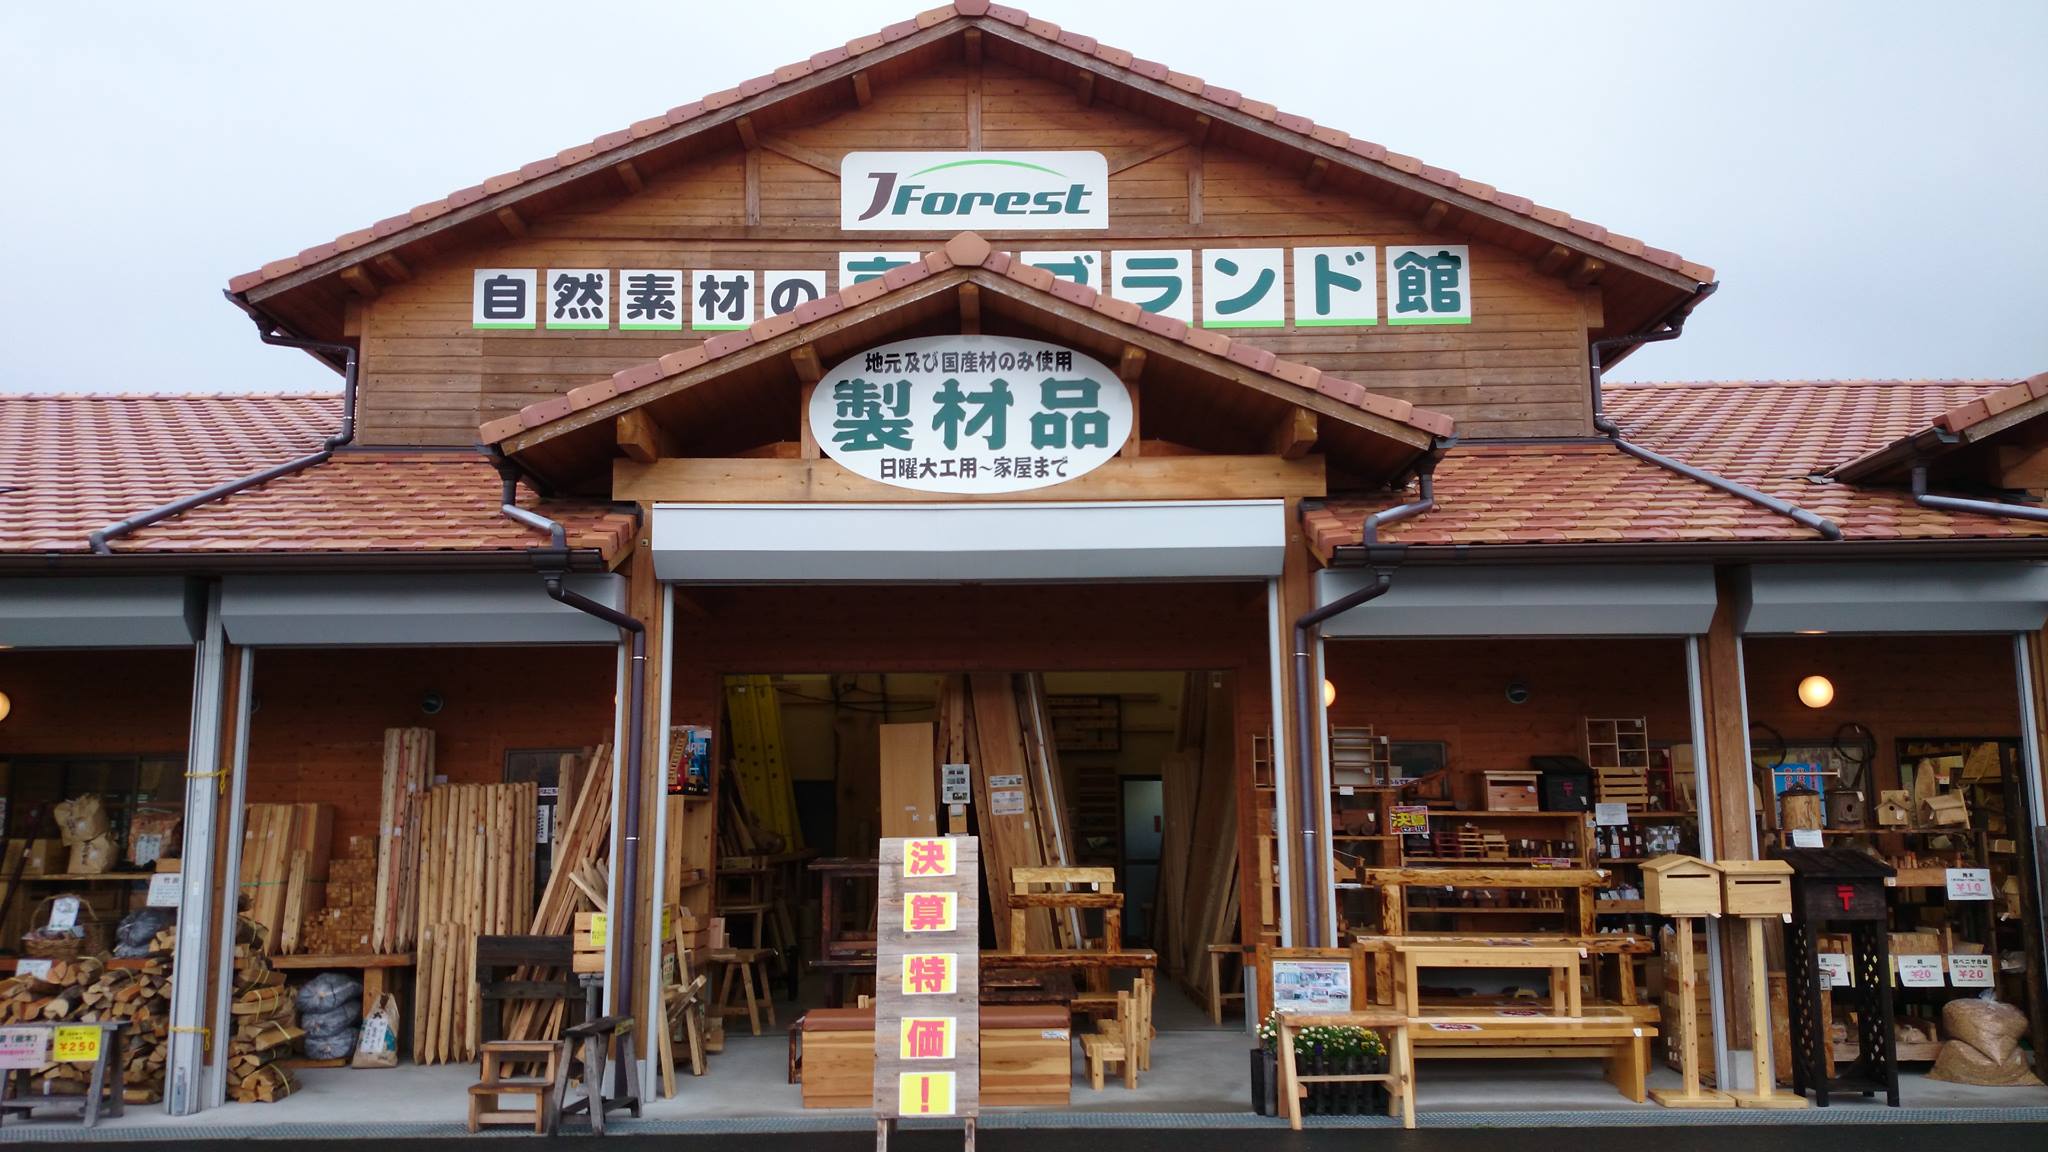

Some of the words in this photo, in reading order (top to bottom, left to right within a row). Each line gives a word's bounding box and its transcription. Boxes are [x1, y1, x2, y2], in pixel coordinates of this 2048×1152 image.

[864, 350, 1073, 374] 地元及び国産材のみ使用
[832, 377, 1111, 452] 製材品
[1958, 969, 1984, 979] ￥20
[59, 1041, 96, 1052] ￥250
